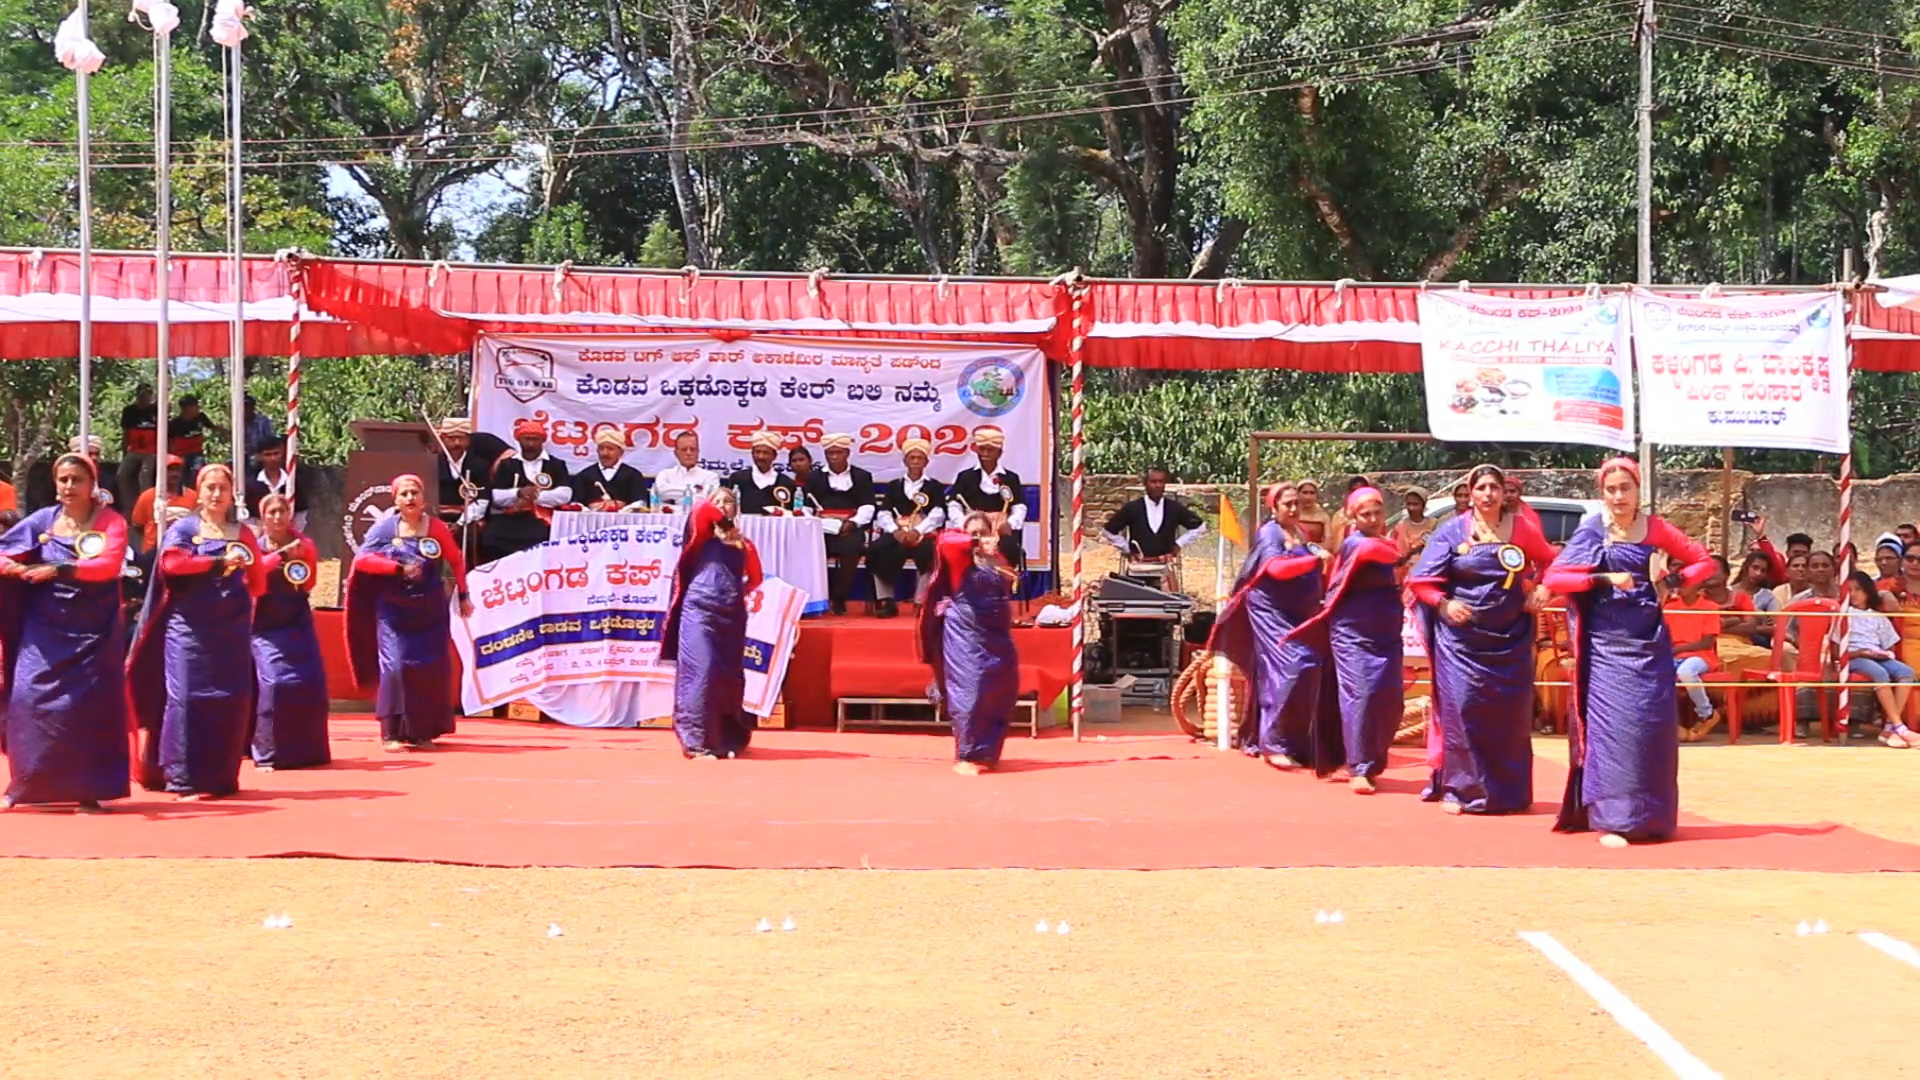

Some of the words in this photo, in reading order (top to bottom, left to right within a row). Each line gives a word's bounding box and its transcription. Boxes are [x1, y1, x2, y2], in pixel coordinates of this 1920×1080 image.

[578, 348, 626, 362] ಕೊಡವ
[633, 349, 664, 363] ಟಗ್
[708, 349, 744, 363] ವಾರ್
[831, 354, 882, 373] ಮಾನ್ಯತೆ
[1439, 339, 1519, 355] KACCHI
[1528, 339, 1616, 356] THALIYA
[576, 373, 649, 396] ಕೊಡವ
[660, 373, 767, 408] ಒಕ್ಕಡೊಕ್ಕಡ
[780, 376, 835, 399] ಕೇರ್
[848, 383, 883, 401] ಬಲಿ
[895, 381, 942, 412] ನಮ್ಮೆ
[481, 560, 589, 609] ಚೆಟ್ಟಂಗಡ
